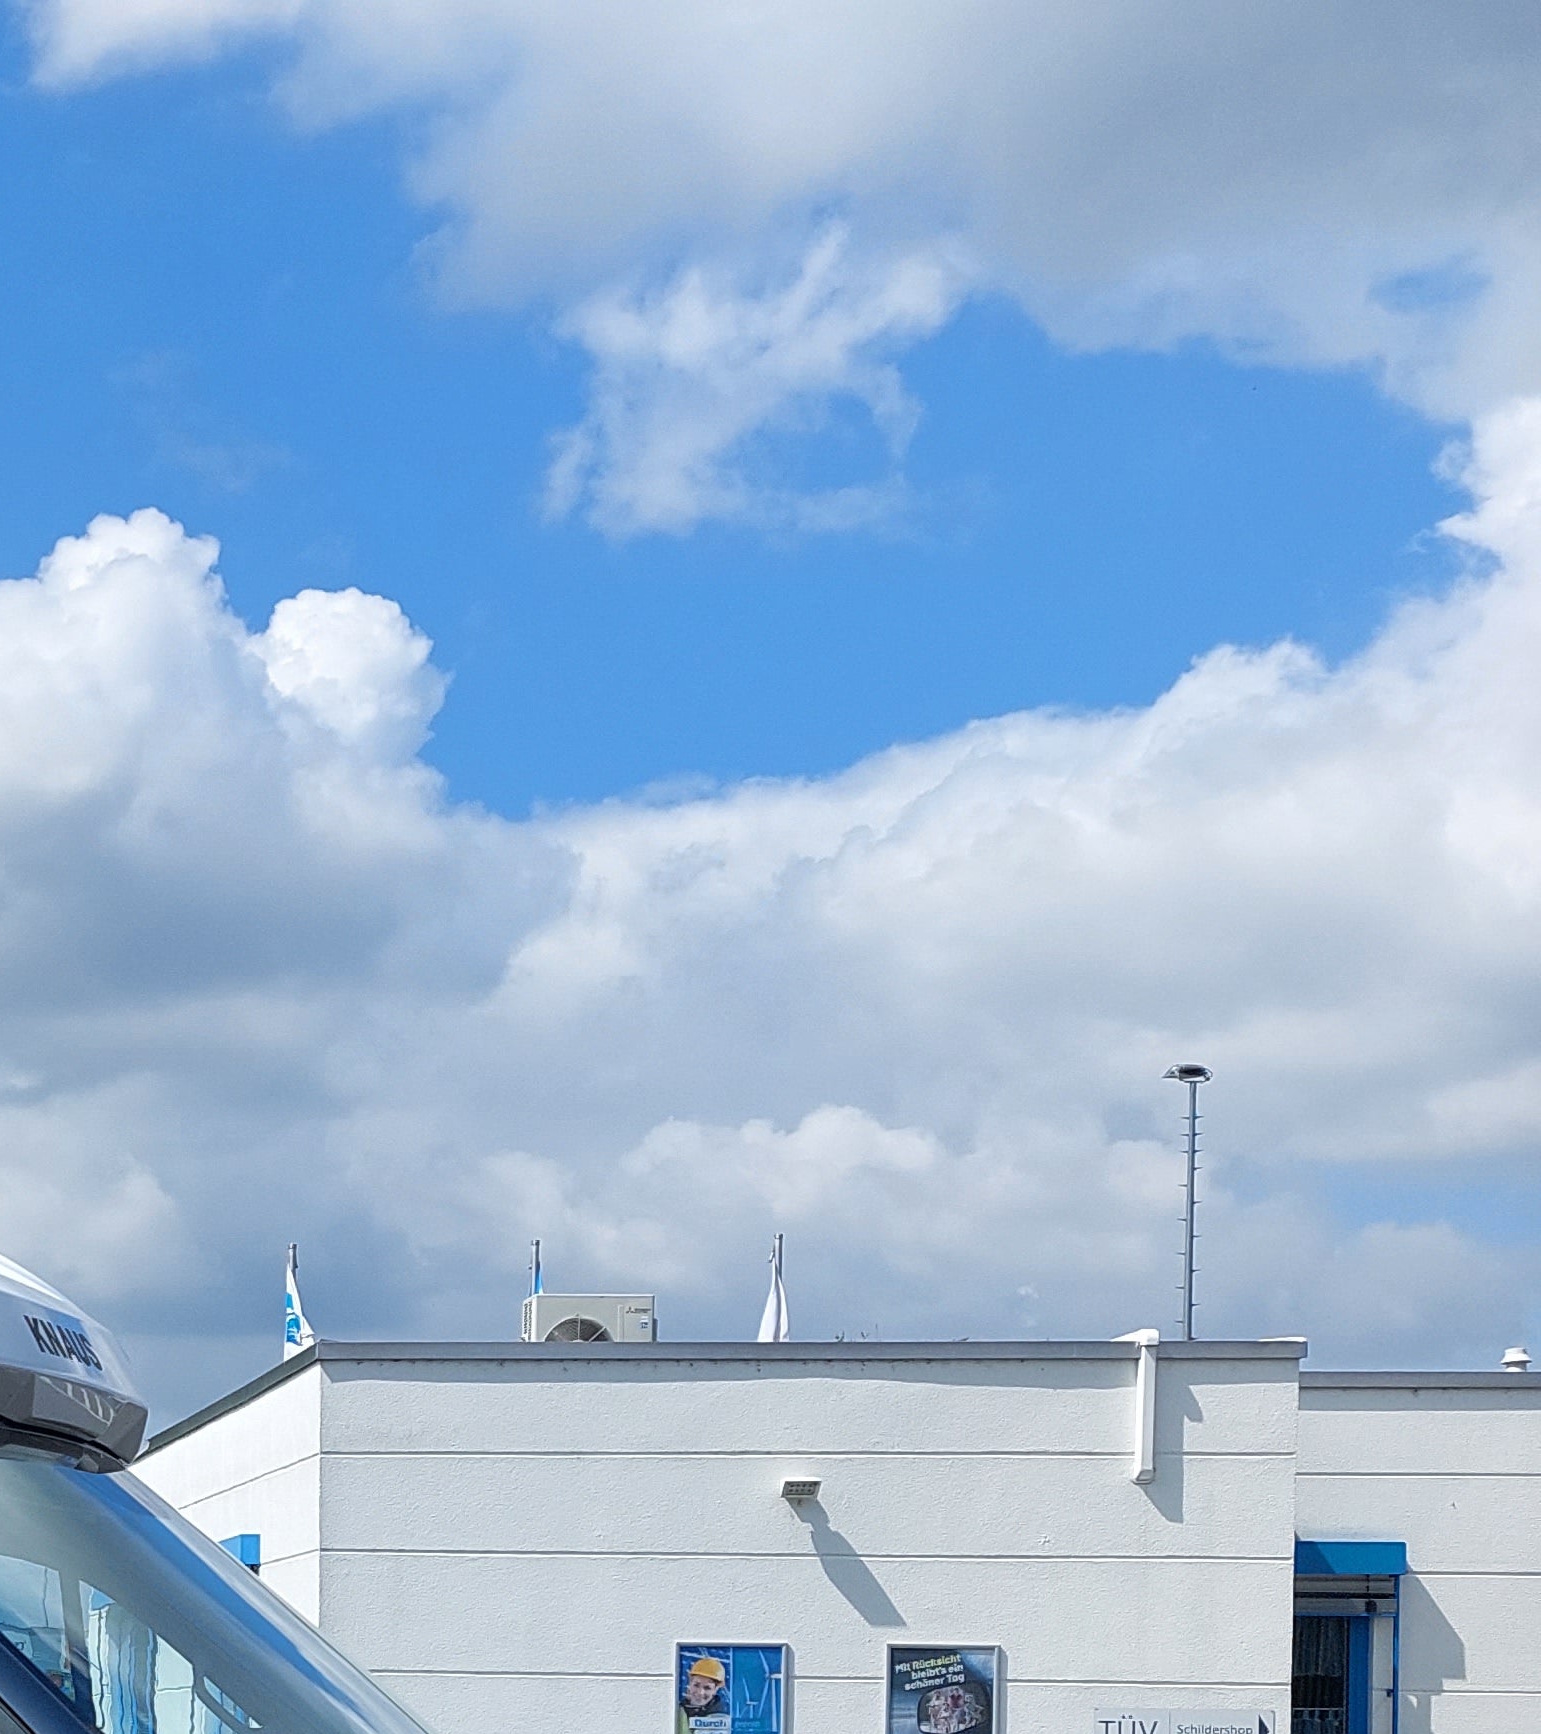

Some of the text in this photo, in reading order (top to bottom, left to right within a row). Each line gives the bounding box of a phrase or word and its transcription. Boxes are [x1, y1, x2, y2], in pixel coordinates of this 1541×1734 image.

[23, 1315, 103, 1371] KNAUS
[946, 1674, 965, 1683] Tag
[694, 1718, 727, 1727] Durch
